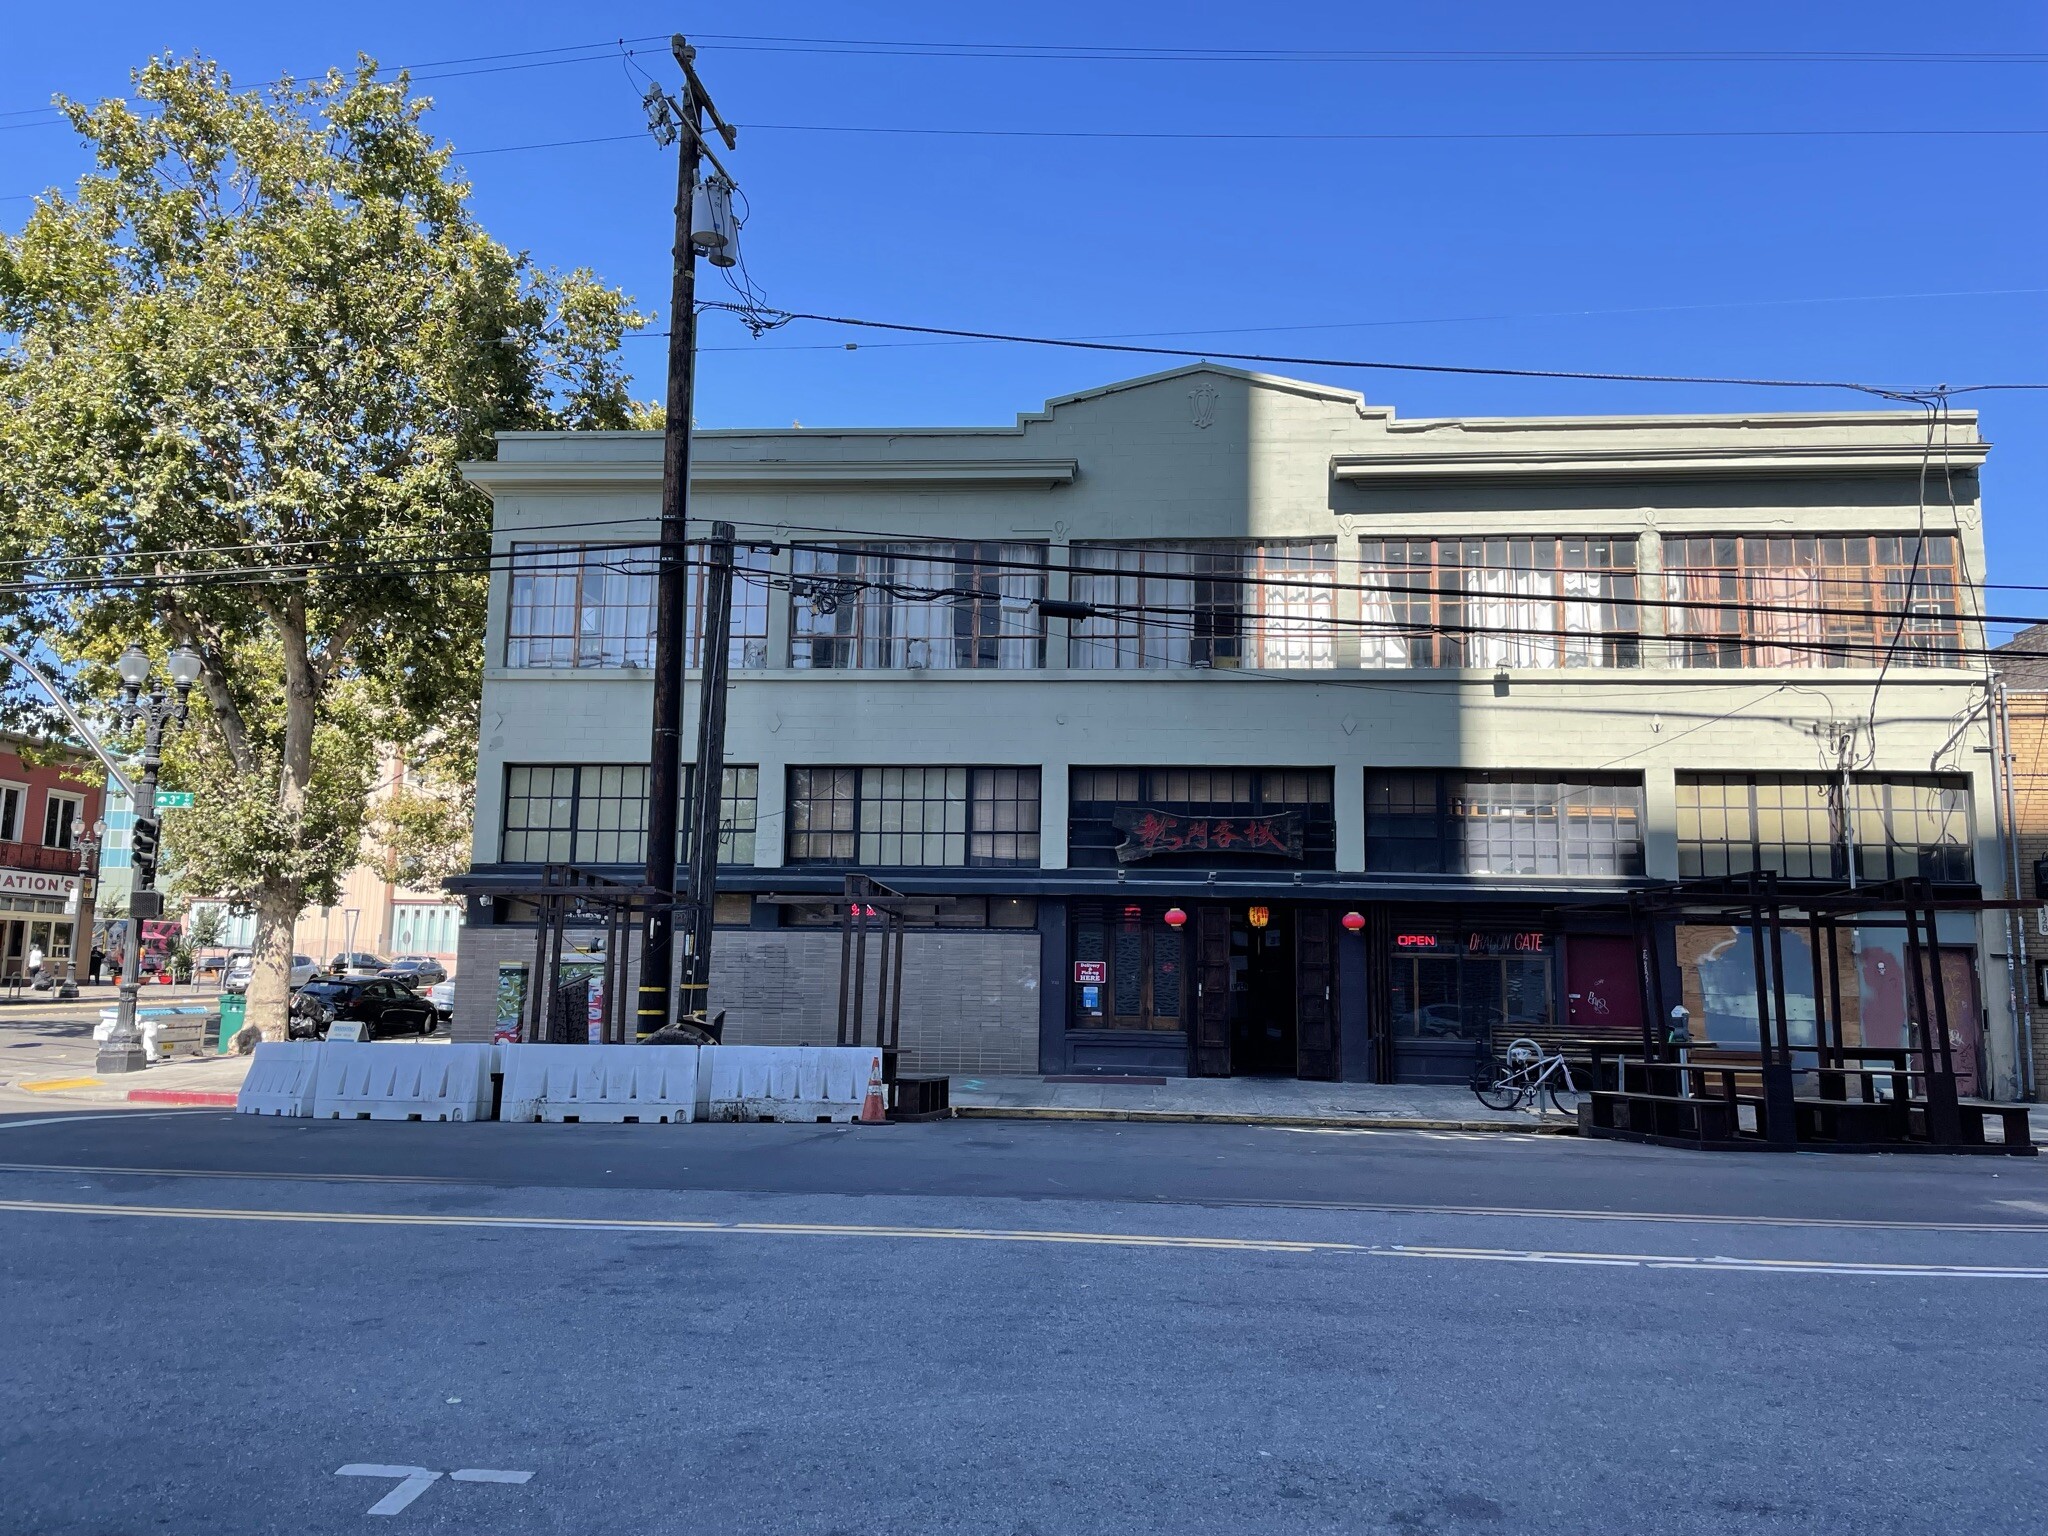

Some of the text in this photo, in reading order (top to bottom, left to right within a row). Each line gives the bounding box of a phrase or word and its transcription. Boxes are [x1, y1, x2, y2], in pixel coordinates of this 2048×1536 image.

[0, 874, 74, 893] ATION'S
[1398, 935, 1435, 946] OPEN
[1514, 933, 1544, 951] GATE
